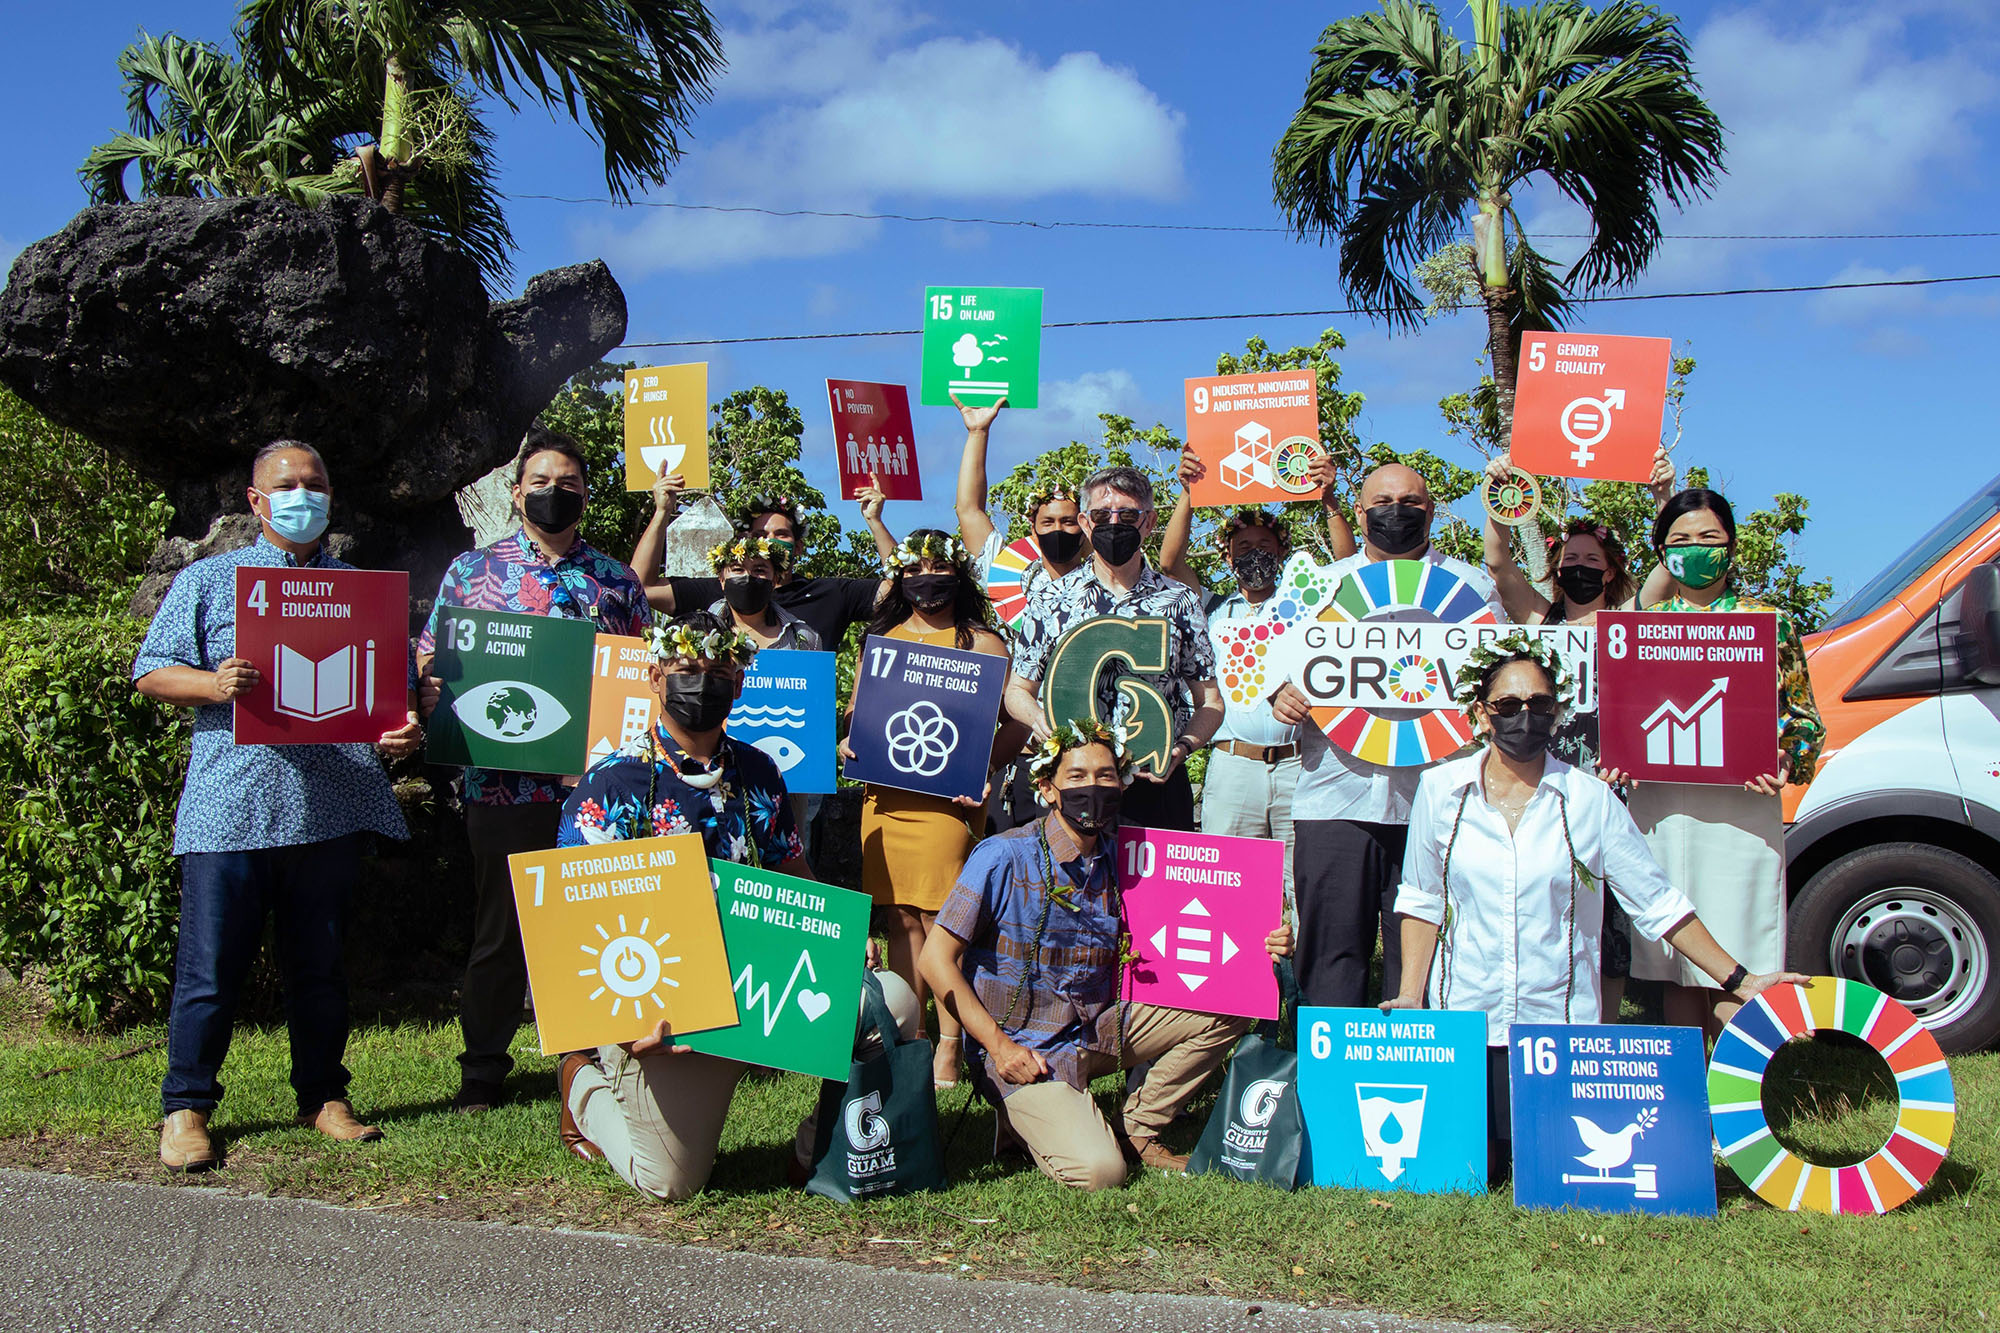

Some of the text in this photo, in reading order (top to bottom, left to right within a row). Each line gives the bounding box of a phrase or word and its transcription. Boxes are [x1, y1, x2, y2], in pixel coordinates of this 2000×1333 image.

[930, 295, 953, 320] 15
[960, 296, 977, 306] LIFE
[960, 310, 995, 321] ON LAND
[1529, 342, 1546, 372] 5
[1557, 343, 1599, 357] GENDER
[1555, 360, 1606, 375] EQUALITY
[629, 378, 639, 404] 2
[643, 376, 658, 388] ZERO
[1212, 379, 1310, 397] INDUSTRY, INNOVATION
[643, 390, 668, 402] HUNGER
[833, 388, 842, 413] 1
[845, 388, 855, 399] NO
[1193, 386, 1210, 414] 9
[1213, 395, 1310, 413] AND INFRASTRUCTURE
[847, 403, 874, 415] POVERTY
[247, 579, 270, 617] 4
[281, 580, 335, 598] QUALITY
[281, 602, 351, 618] EDUCATION
[444, 617, 477, 651] 13
[487, 621, 533, 639] CLIMATE
[1305, 626, 1588, 653] GUAM GRN
[1637, 624, 1756, 641] DECENT WORK AND
[485, 640, 526, 657] ACTION
[1608, 623, 1628, 660] 8
[870, 647, 898, 679] 17
[1638, 645, 1764, 662] ECONOMIC GROWTH
[616, 666, 639, 681] AND
[906, 652, 981, 677] PARTNERSHIPS
[775, 677, 807, 690] WATER
[903, 669, 979, 694] FOR THE GOALS
[1043, 614, 1175, 778] G
[1124, 840, 1156, 878] 10
[1166, 843, 1220, 863] REDUCED
[561, 849, 676, 879] AFFORDABLE AND
[525, 865, 545, 907] 7
[1165, 865, 1242, 888] INEQUALITIES
[564, 874, 662, 903] CLEAN ENERGY
[734, 877, 773, 901] GOOD
[775, 886, 826, 913] HEALTH
[729, 899, 842, 940] AND WELL-BEING
[1310, 1020, 1332, 1060] 6
[1344, 1022, 1436, 1040] CLEAN WATER
[1344, 1044, 1455, 1063] AND SANITATION
[1517, 1036, 1558, 1076] 16
[1569, 1037, 1673, 1056] PEACE, JUSTICE
[1570, 1060, 1658, 1078] AND STRONG
[1571, 1082, 1665, 1101] INSTITUTIONS
[1240, 1079, 1289, 1128] G
[845, 1089, 890, 1152] G
[1225, 1128, 1268, 1149] GUAM
[847, 1153, 896, 1174] GUAM
